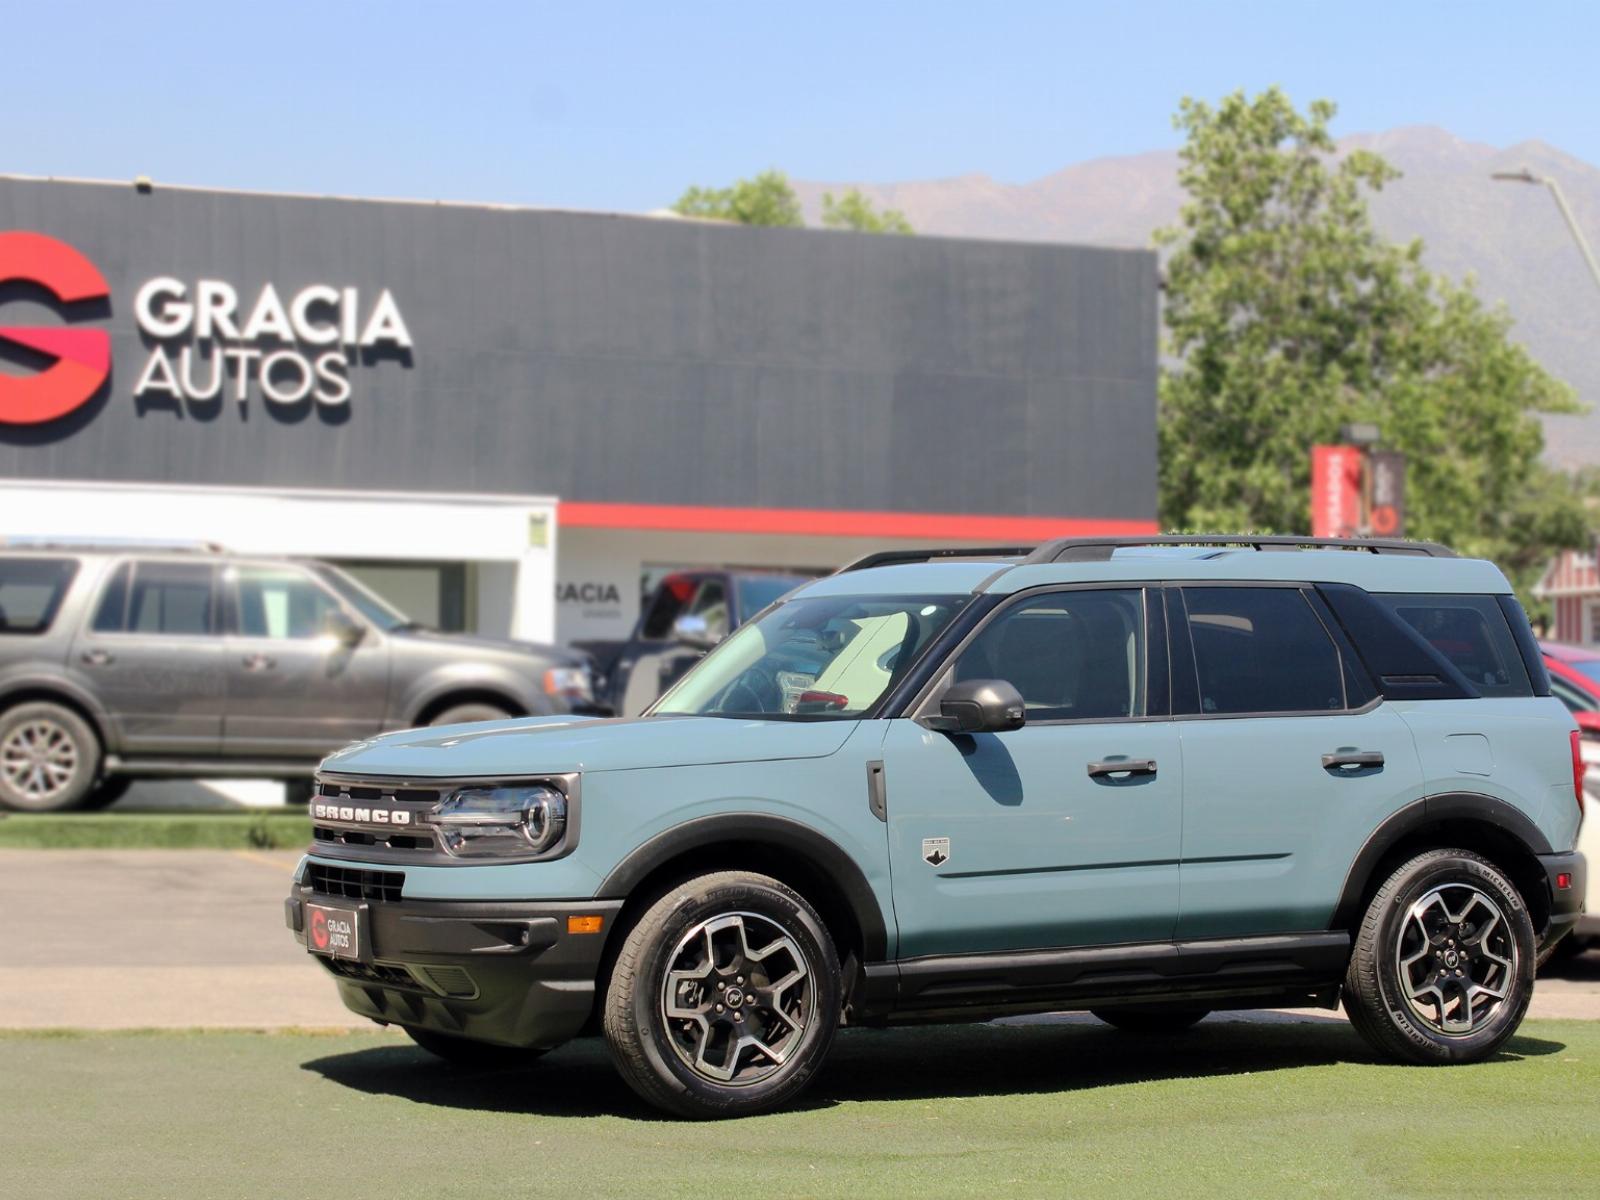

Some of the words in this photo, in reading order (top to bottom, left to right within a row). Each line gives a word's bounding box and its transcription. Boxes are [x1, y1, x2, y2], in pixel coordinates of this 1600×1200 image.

[135, 277, 413, 347] GRACIA
[134, 345, 352, 405] AUTOS
[553, 582, 620, 604] RACIA
[315, 804, 410, 824] BRONCO
[1480, 869, 1520, 908] MICHELIN
[327, 919, 351, 935] GRACIA
[329, 933, 350, 949] AUTOS
